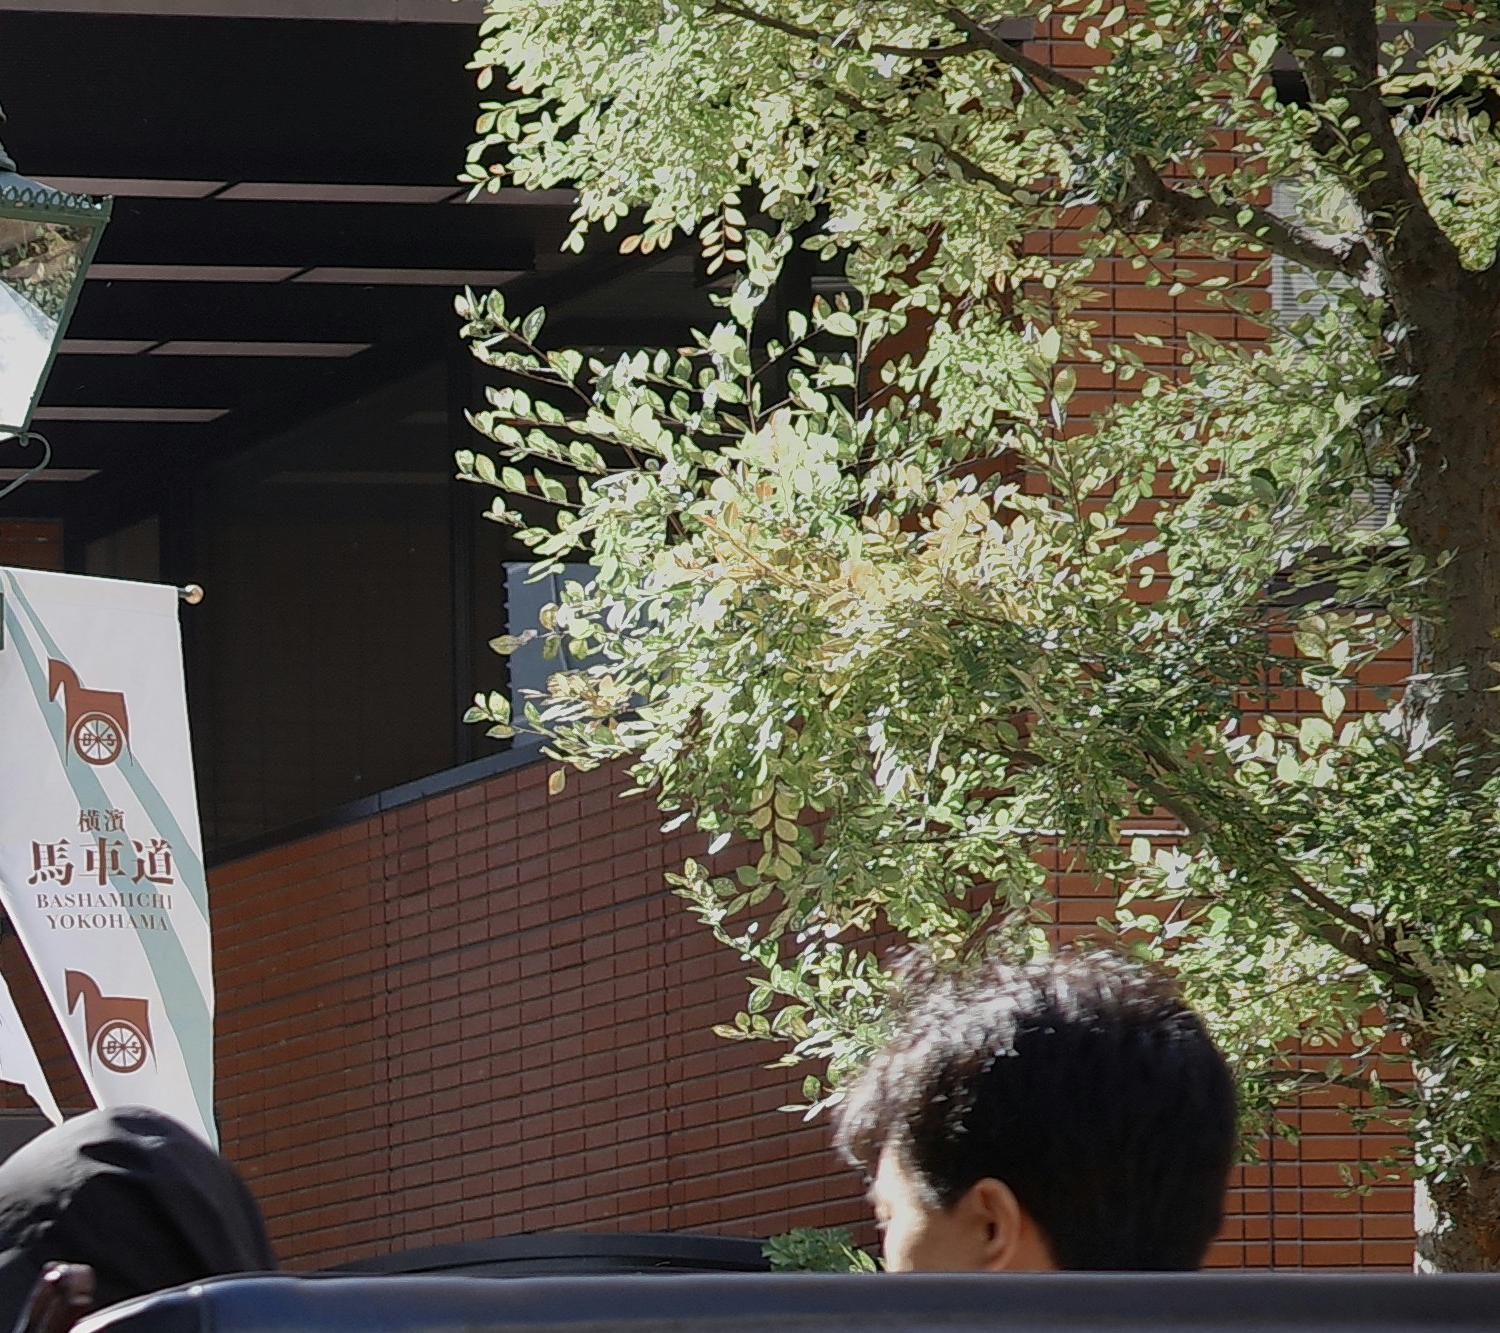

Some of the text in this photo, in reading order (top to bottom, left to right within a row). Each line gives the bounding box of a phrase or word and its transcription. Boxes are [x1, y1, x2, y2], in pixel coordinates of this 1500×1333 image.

[78, 808, 125, 833] 横濱
[28, 836, 175, 886] 馬車道
[36, 891, 174, 910] BASHAMICHI
[46, 913, 169, 932] YOKOHAMA
